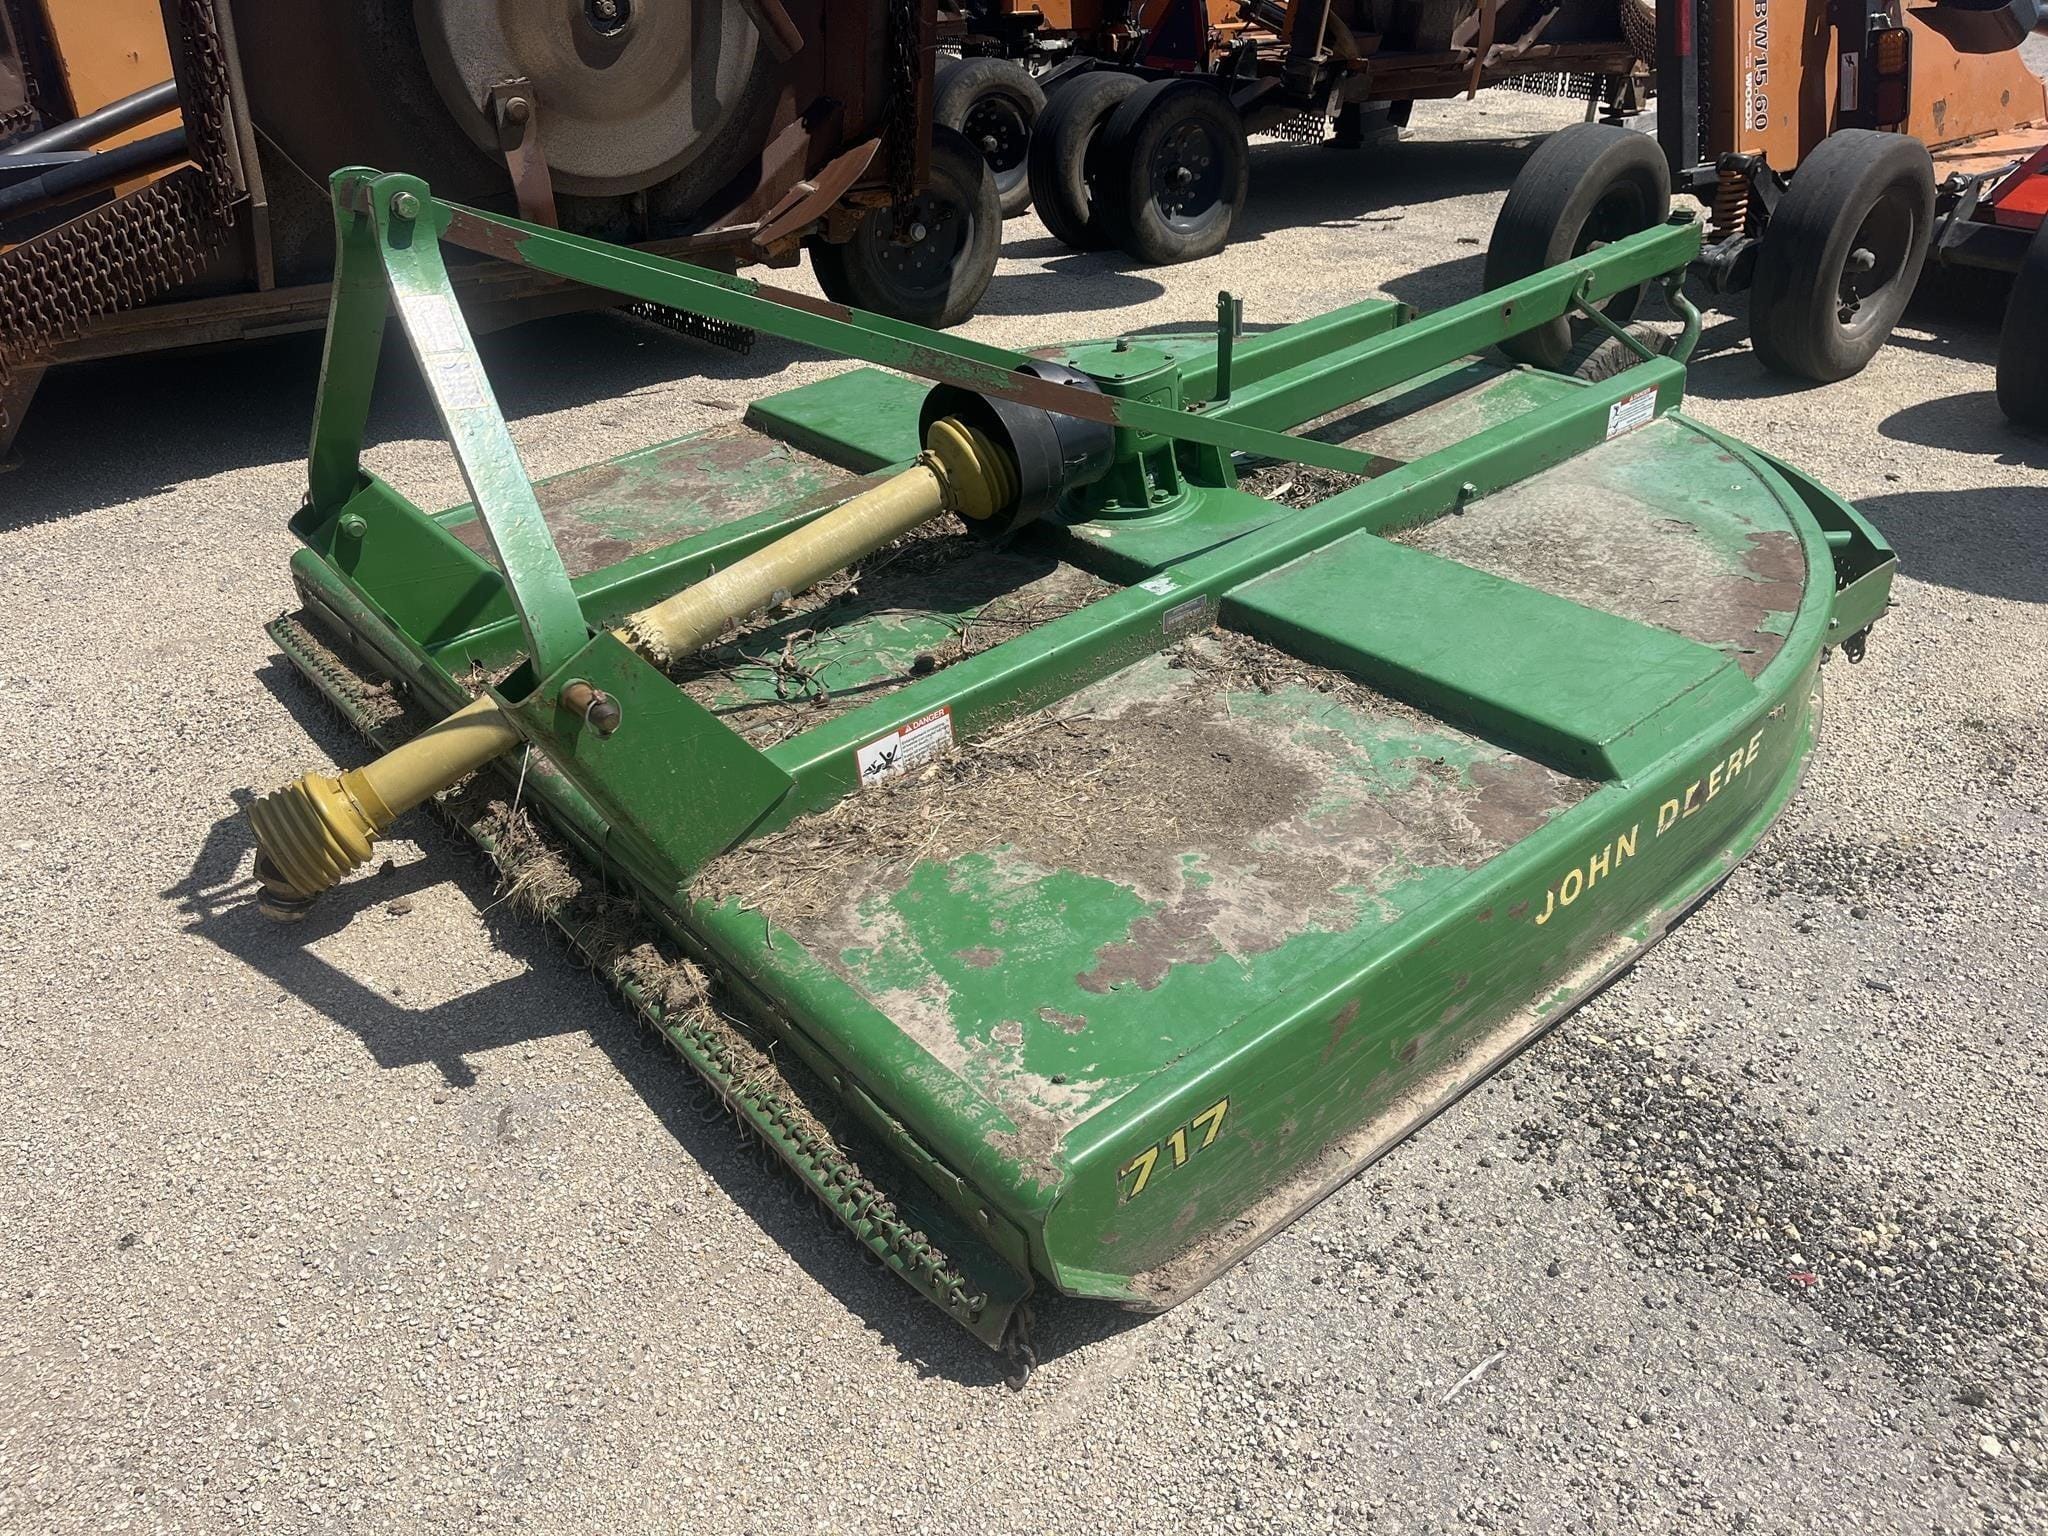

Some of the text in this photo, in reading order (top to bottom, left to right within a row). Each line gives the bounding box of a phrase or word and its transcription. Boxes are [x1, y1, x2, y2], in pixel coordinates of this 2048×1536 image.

[1745, 71, 1753, 131] WOODS
[912, 708, 945, 730] DANGER
[1535, 823, 1639, 926] JOHN
[1117, 1094, 1230, 1202] 717
